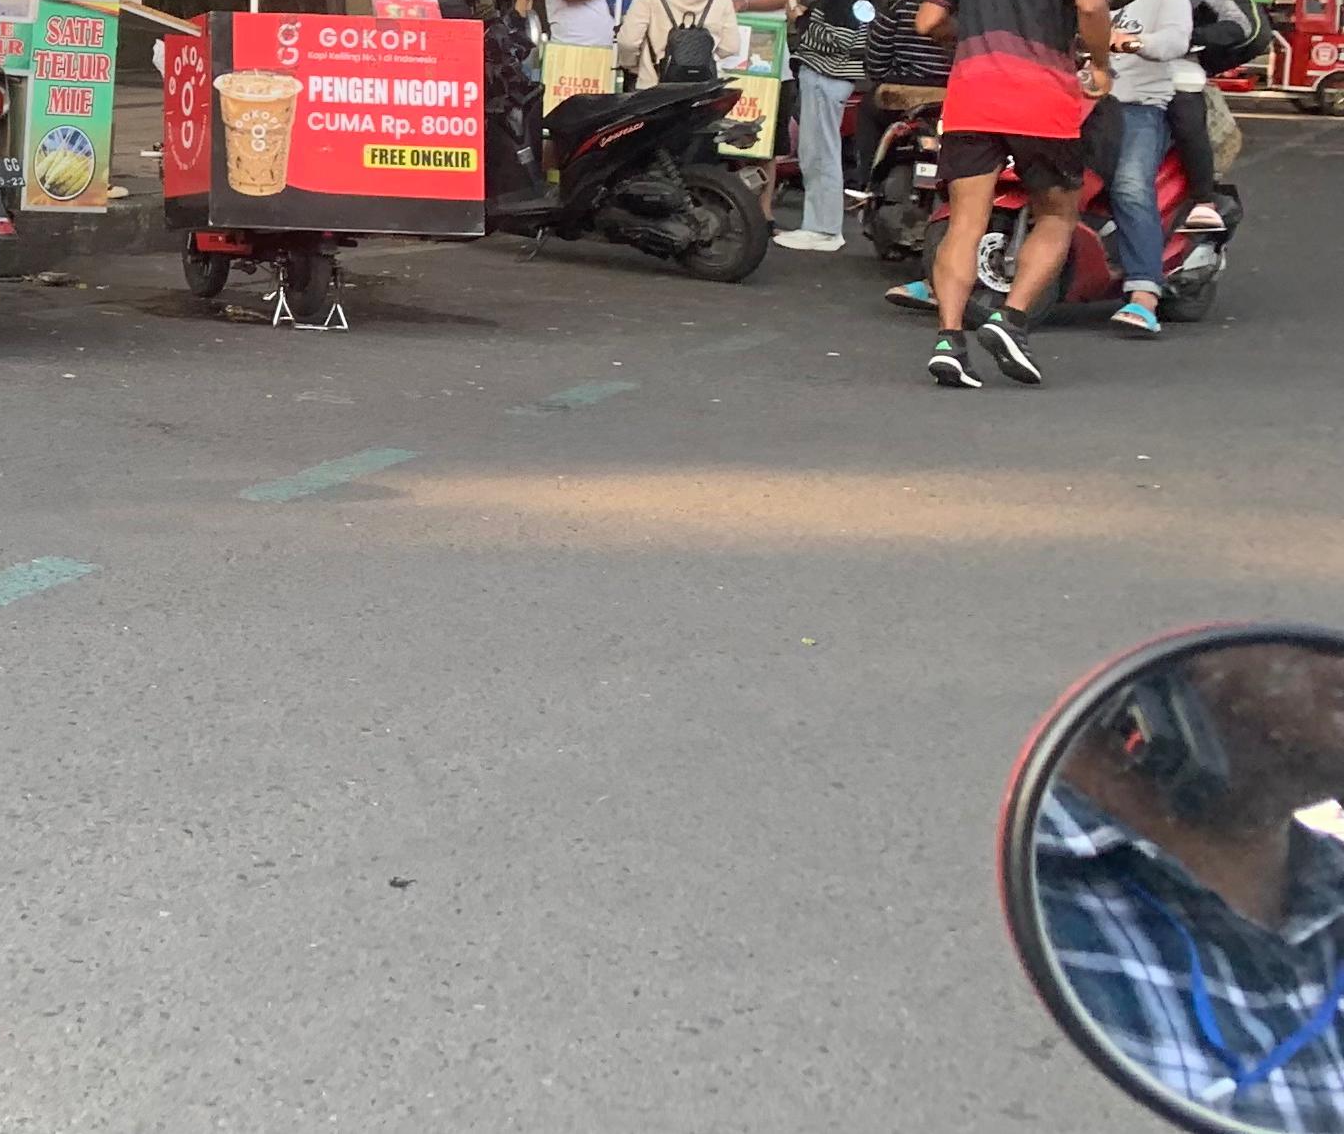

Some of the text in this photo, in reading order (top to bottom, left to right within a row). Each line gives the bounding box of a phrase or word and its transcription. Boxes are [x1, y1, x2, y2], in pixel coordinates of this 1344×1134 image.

[45, 16, 105, 48] SATE
[318, 27, 427, 51] GOKOPI
[33, 49, 112, 83] TELUR
[308, 76, 479, 109] PENGEN NGOPI ?
[558, 75, 600, 89] CILOK
[45, 85, 94, 117] MIE
[307, 111, 478, 141] CUMA Rp. 8000
[370, 147, 471, 169] FREE ONGKIR
